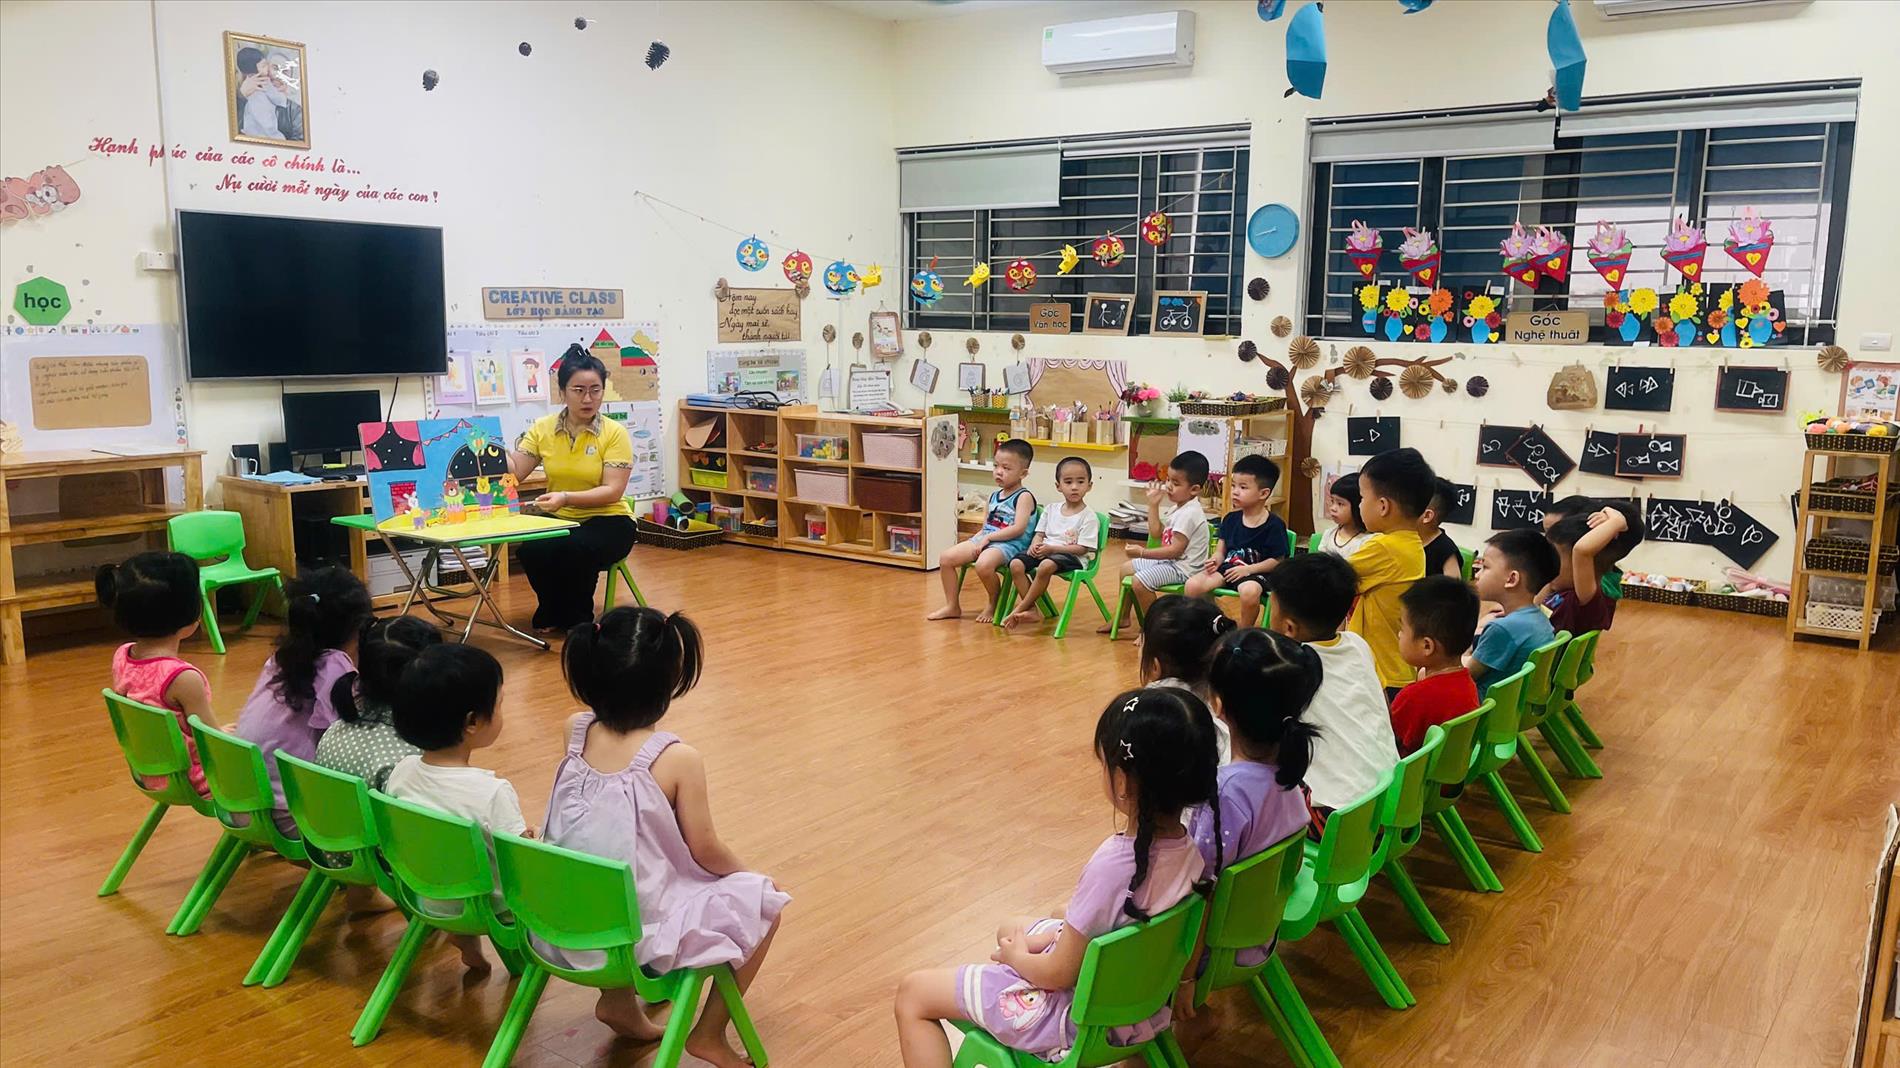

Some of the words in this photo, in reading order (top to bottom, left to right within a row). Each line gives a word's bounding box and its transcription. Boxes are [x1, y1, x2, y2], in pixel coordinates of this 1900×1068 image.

[88, 137, 138, 156] Hạnh
[195, 145, 222, 162] của
[231, 151, 254, 165] các
[262, 155, 277, 167] cô
[284, 154, 324, 172] chính
[216, 174, 241, 193] Nụ
[282, 179, 310, 195] mỗi
[314, 183, 349, 201] ngày
[356, 184, 379, 199] của
[384, 187, 403, 201] các
[24, 292, 62, 312] học
[488, 289, 564, 305] CREATIVE
[569, 290, 617, 305] CLASS
[744, 294, 757, 306] nay
[786, 303, 798, 320] hay
[1529, 313, 1561, 327] Góc
[719, 316, 744, 333] Ngày
[746, 319, 760, 327] mai
[1514, 329, 1546, 342] Nghệ
